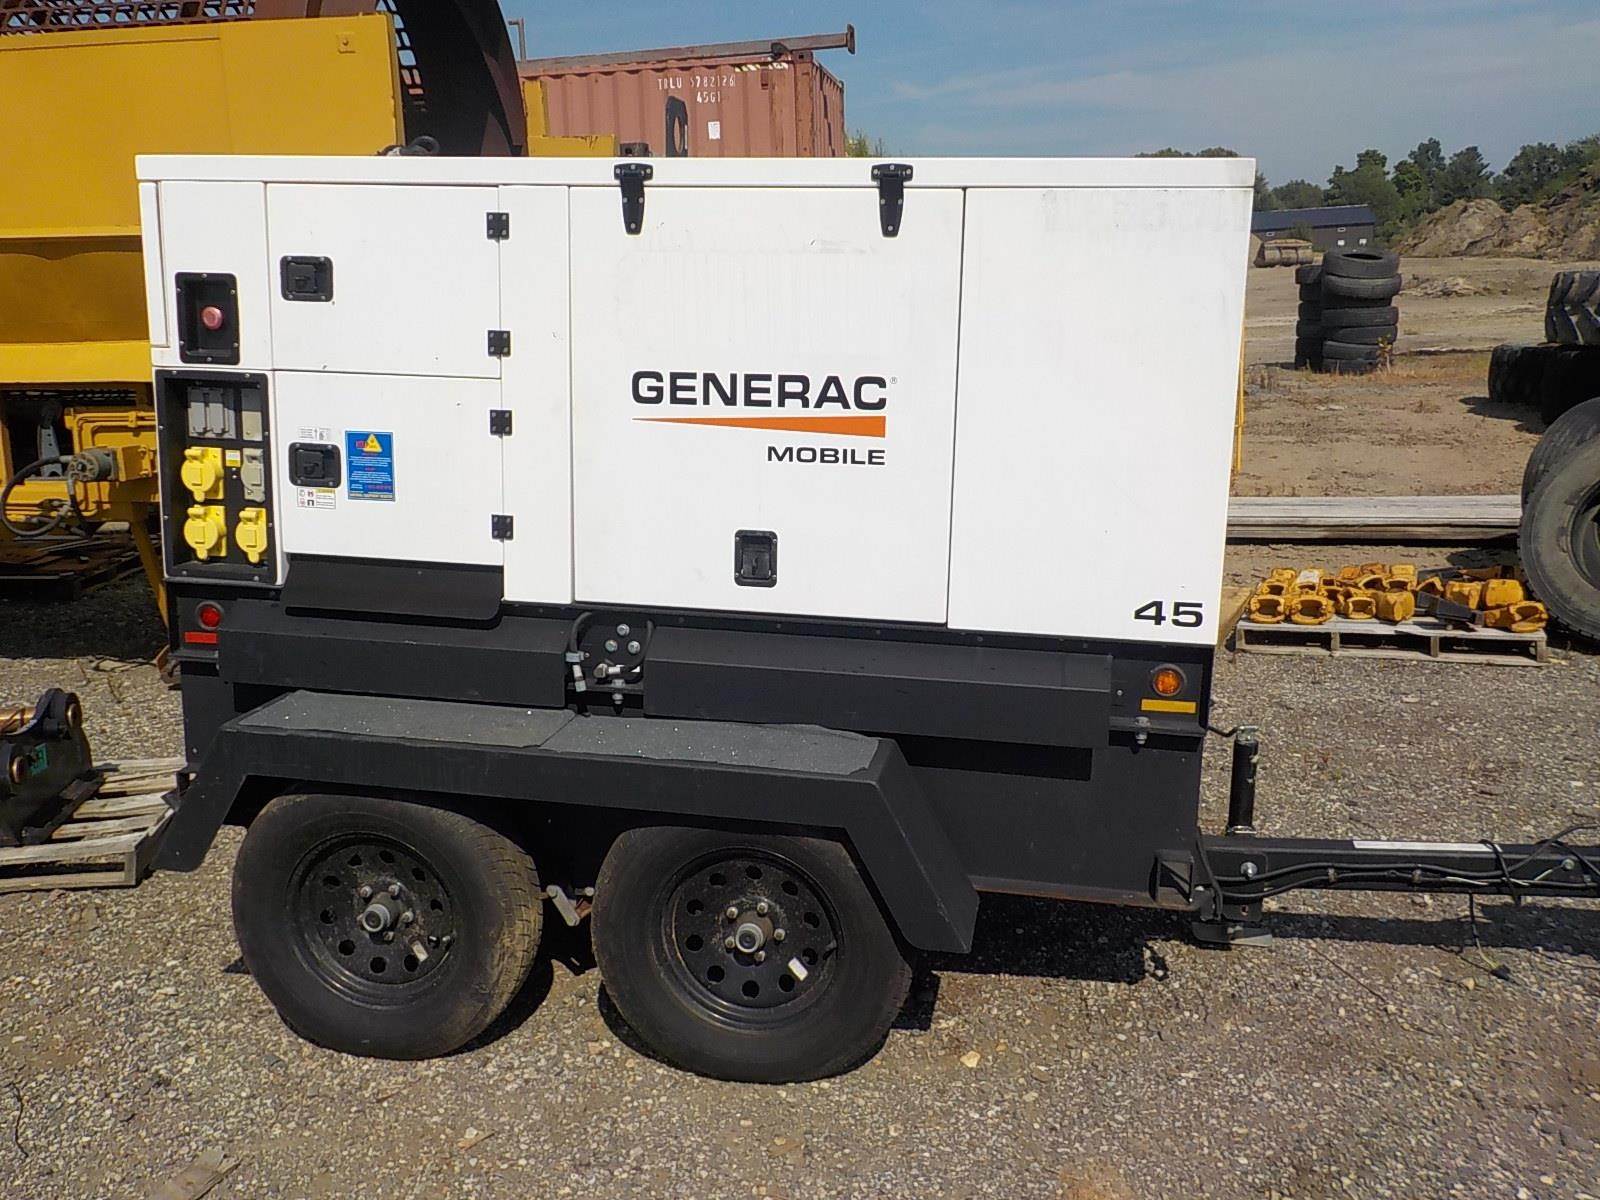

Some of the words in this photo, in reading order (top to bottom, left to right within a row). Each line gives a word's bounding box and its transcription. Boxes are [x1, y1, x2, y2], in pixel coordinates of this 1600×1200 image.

[631, 370, 887, 411] GENERAC
[767, 446, 886, 465] MOBILE
[1134, 600, 1203, 628] 45
